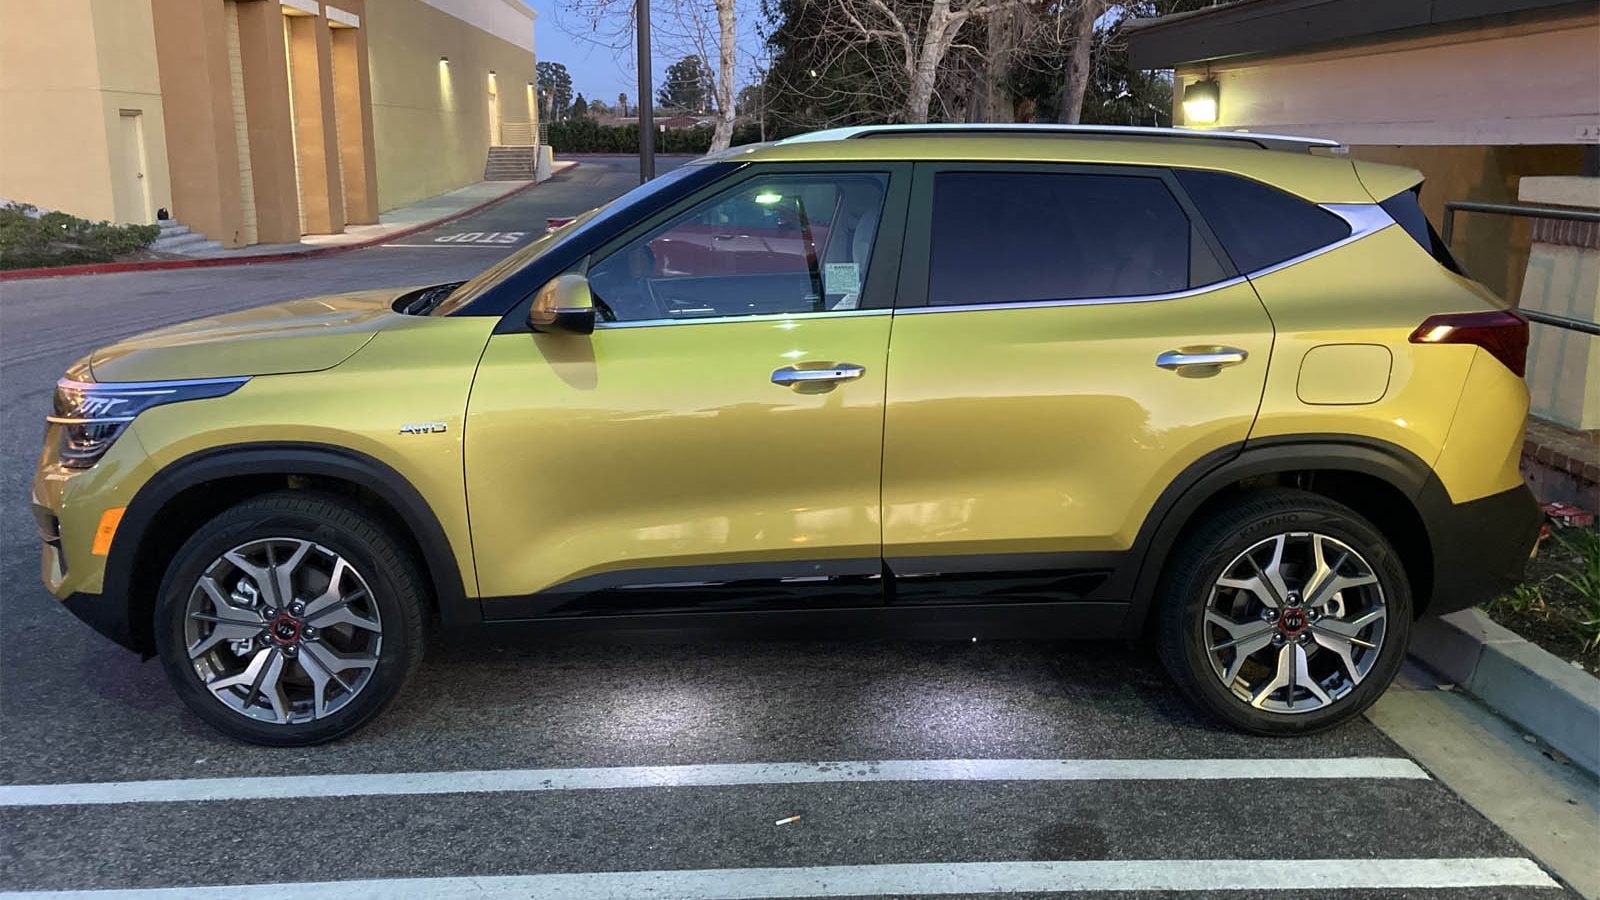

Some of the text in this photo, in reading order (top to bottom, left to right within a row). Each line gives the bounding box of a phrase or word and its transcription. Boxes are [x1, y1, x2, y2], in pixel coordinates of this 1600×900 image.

[434, 232, 525, 243] STOP
[399, 422, 447, 434] AWD
[1240, 514, 1299, 537] KUMHO
